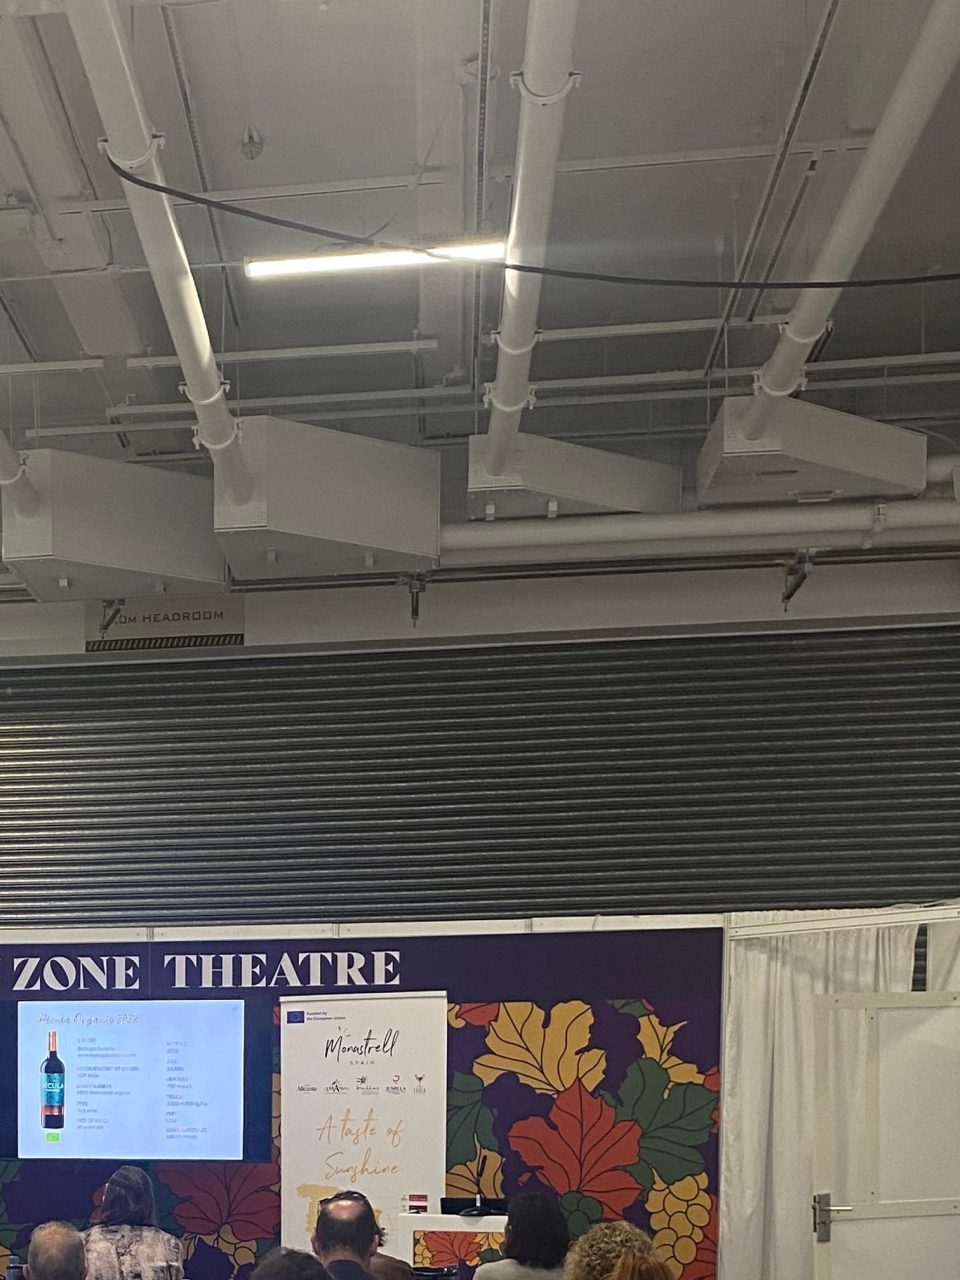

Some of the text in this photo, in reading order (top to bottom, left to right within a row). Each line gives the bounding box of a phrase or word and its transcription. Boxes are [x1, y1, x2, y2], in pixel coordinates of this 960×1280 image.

[142, 610, 224, 623] HEADROOM
[12, 956, 140, 990] ZONE
[164, 951, 401, 988] THEATRE
[324, 1028, 400, 1062] Monastrell
[316, 1107, 407, 1147] A taste of
[324, 1147, 400, 1183] Sunshine
